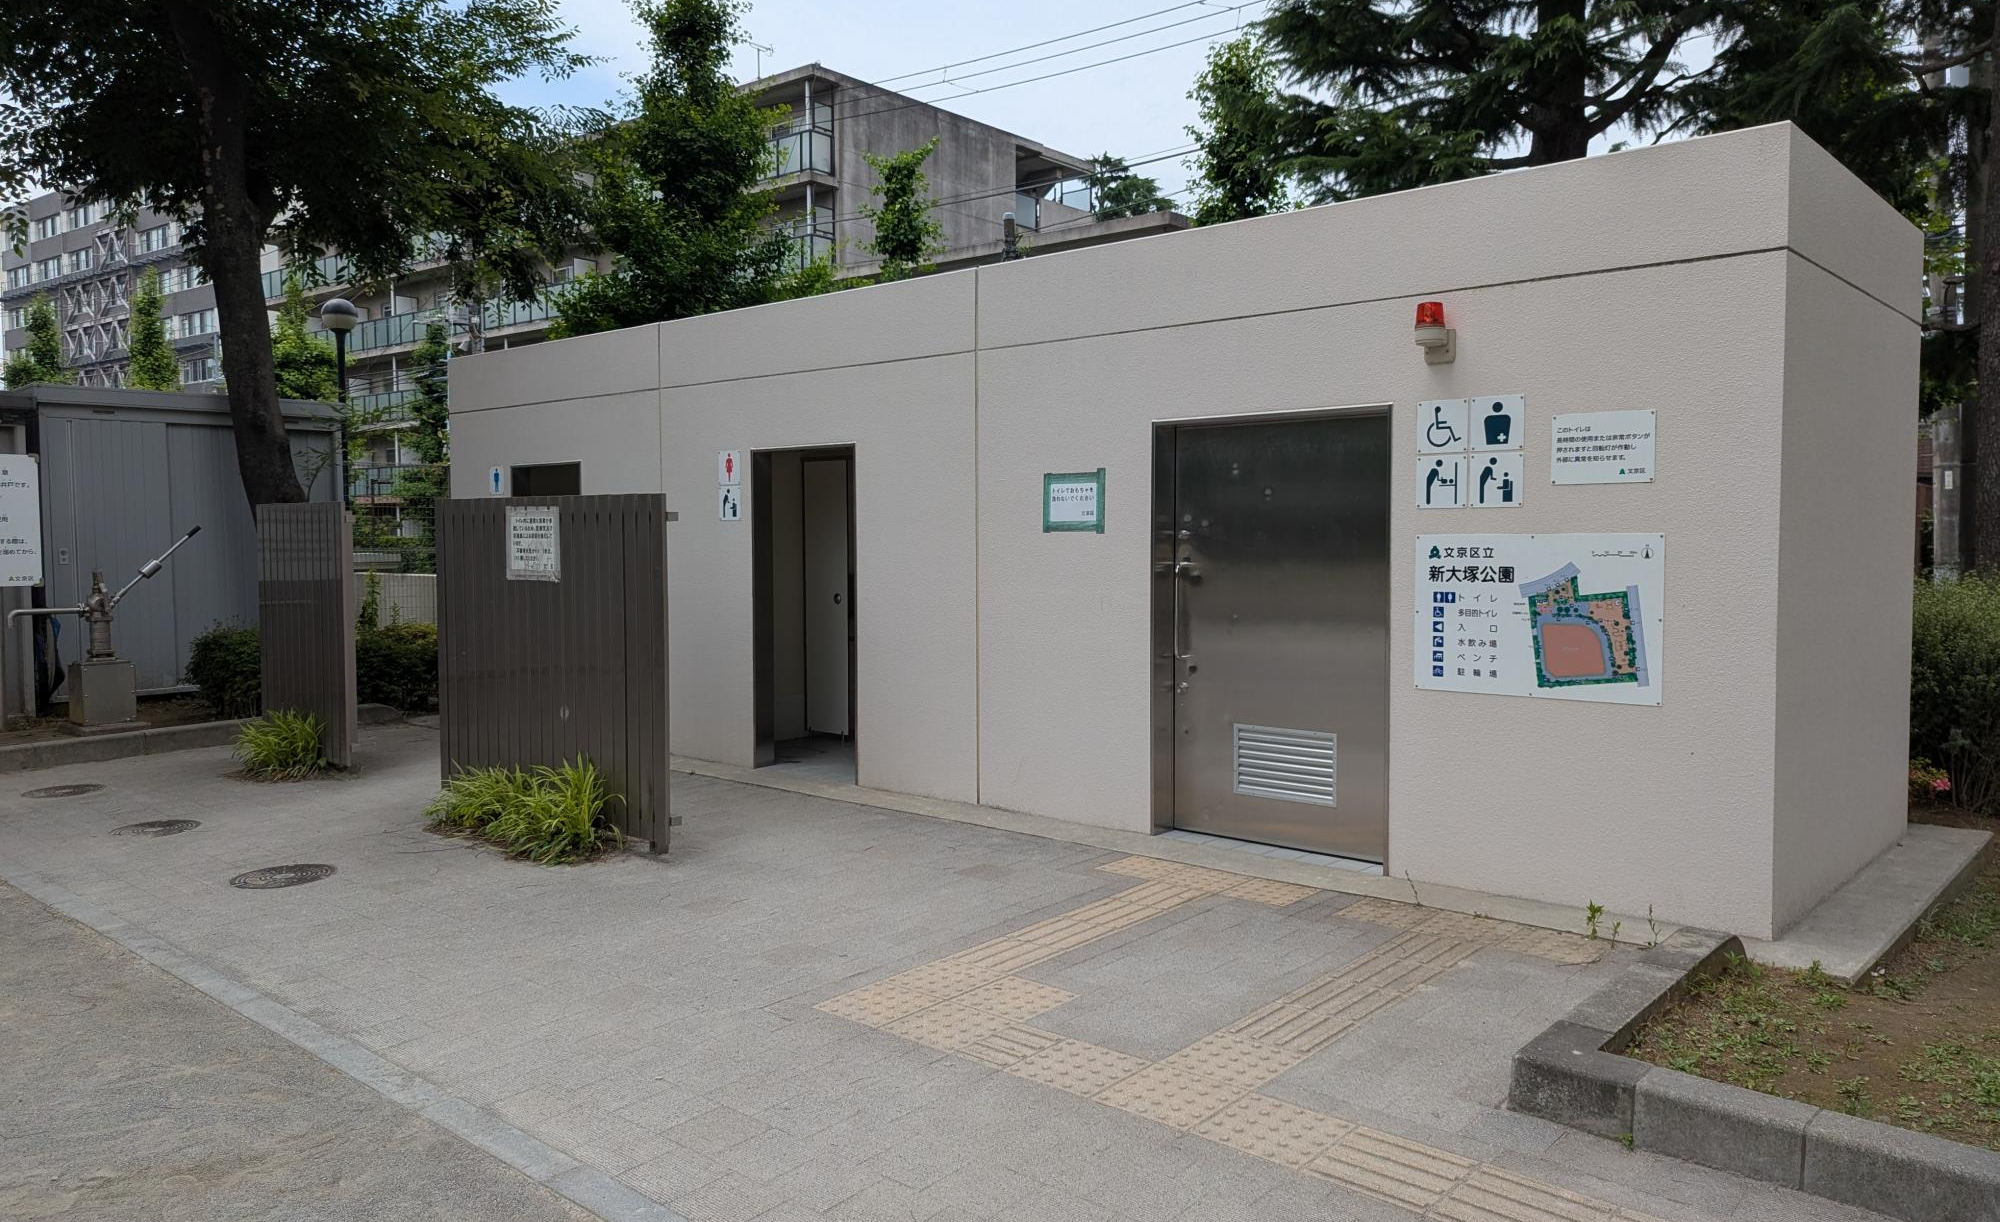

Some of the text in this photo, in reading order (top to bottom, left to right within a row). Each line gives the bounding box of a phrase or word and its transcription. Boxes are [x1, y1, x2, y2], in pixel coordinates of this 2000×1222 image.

[1443, 547, 1494, 559] 文京区立
[1428, 565, 1515, 583] 新大塚公園
[1458, 593, 1498, 603] トイレ
[1457, 608, 1498, 618] 多目的トイレ
[1457, 638, 1497, 648] 水飲み場
[1457, 667, 1497, 678] 駐輪場
